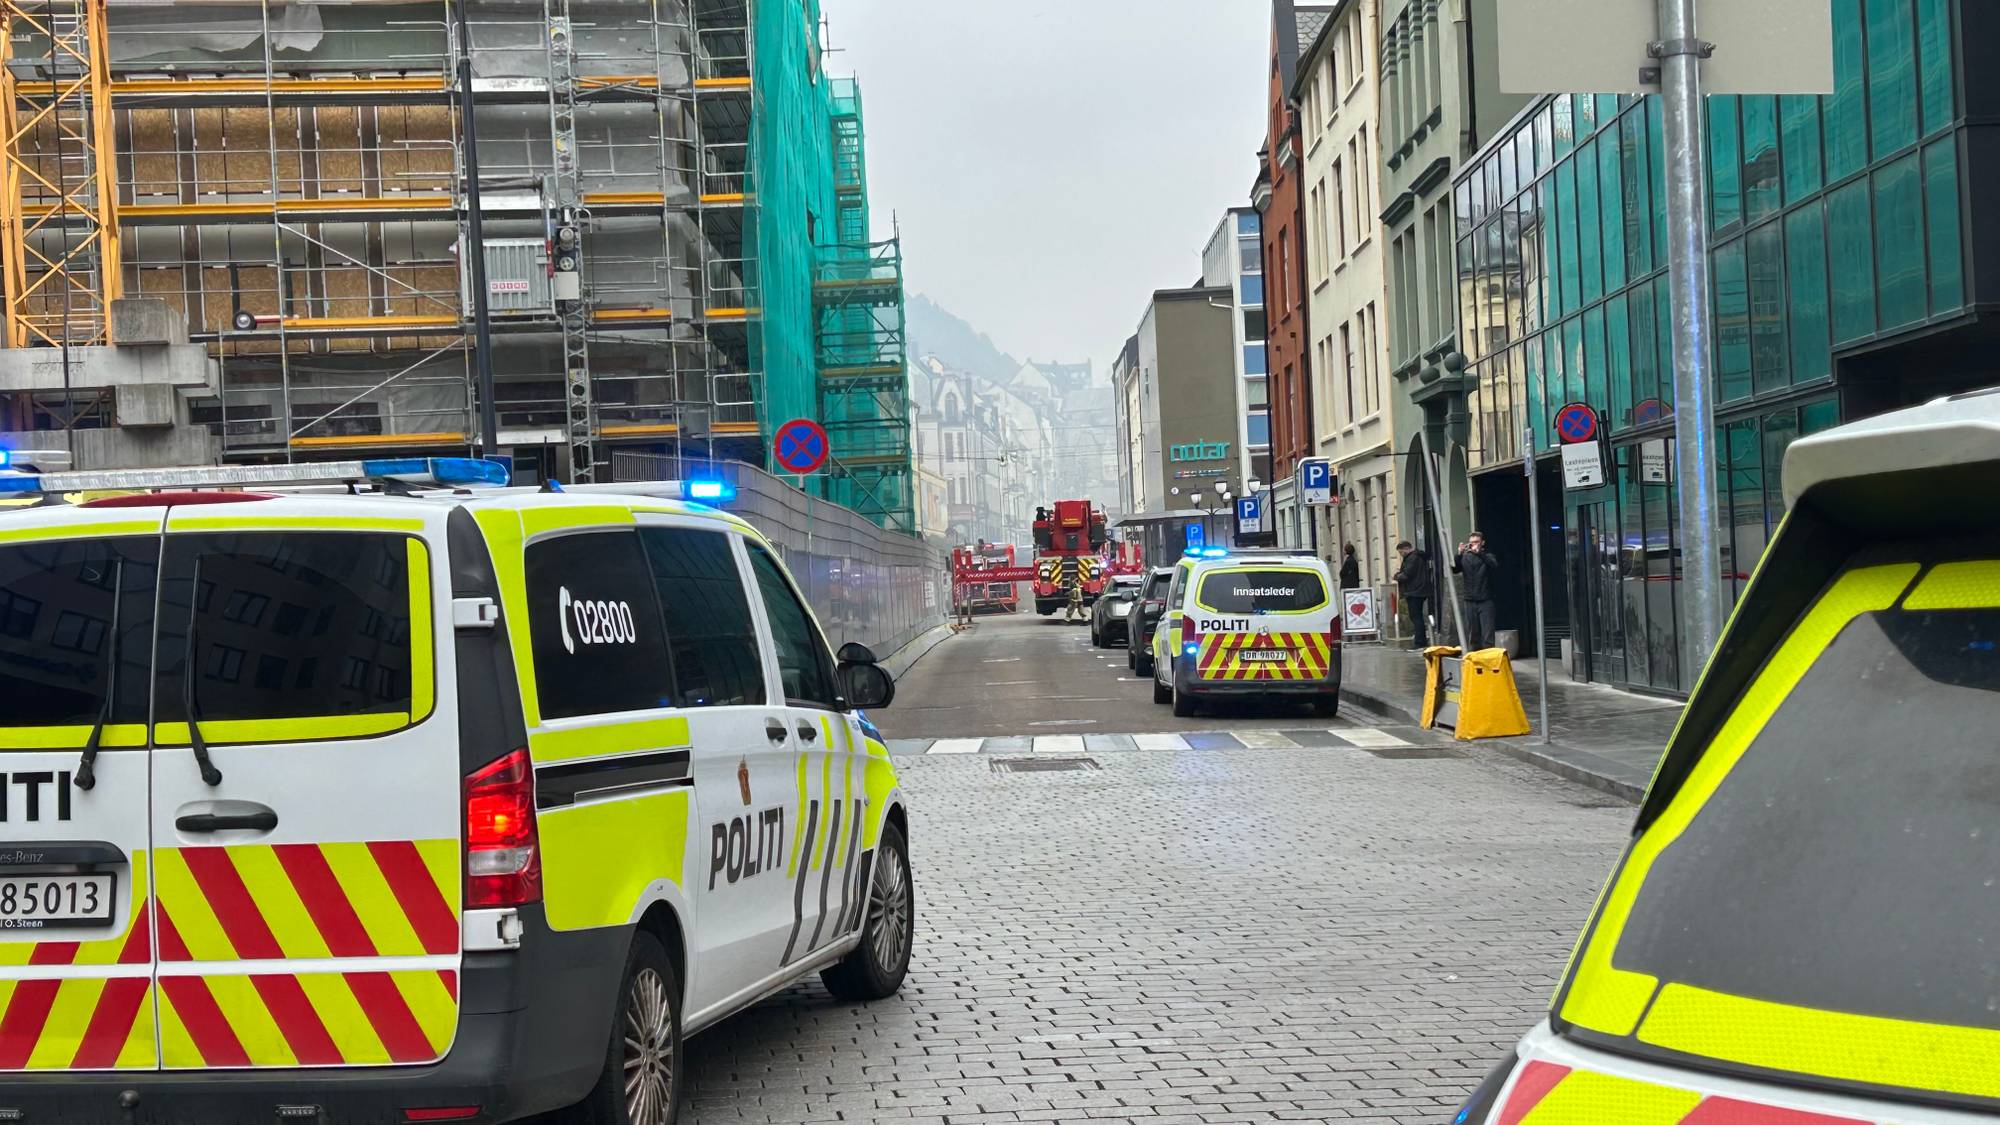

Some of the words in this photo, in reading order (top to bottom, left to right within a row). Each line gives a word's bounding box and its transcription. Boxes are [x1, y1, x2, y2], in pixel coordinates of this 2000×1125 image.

[1170, 438, 1231, 461] notar
[1310, 465, 1324, 486] P
[1244, 501, 1255, 517] P
[1191, 526, 1199, 538] P
[1233, 586, 1295, 596] Innsatsleder
[573, 600, 636, 645] 02800
[1201, 619, 1249, 631] POLITI
[708, 806, 784, 891] POLITI
[0, 882, 98, 915] 85013
[17, 919, 43, 928] Steen
